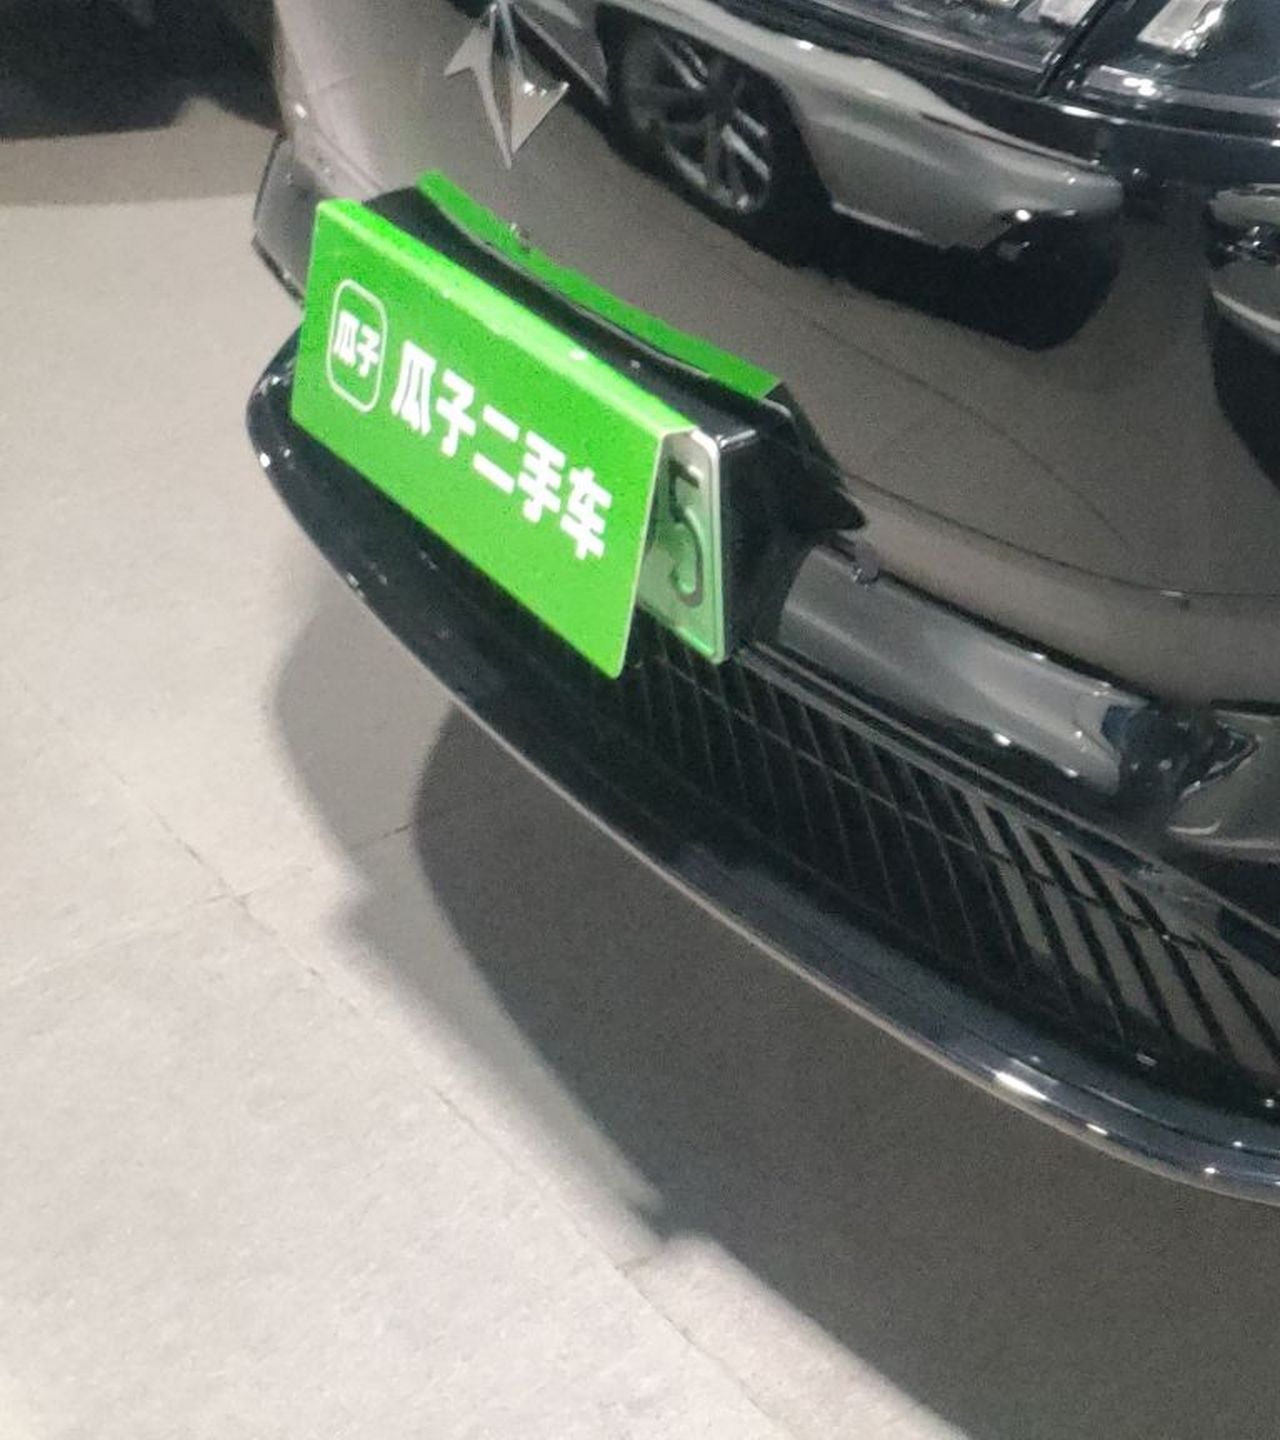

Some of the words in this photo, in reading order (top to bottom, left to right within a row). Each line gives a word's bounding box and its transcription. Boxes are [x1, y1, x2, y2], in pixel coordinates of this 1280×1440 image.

[333, 309, 380, 378] 瓜子
[391, 339, 612, 560] 瓜子二手车
